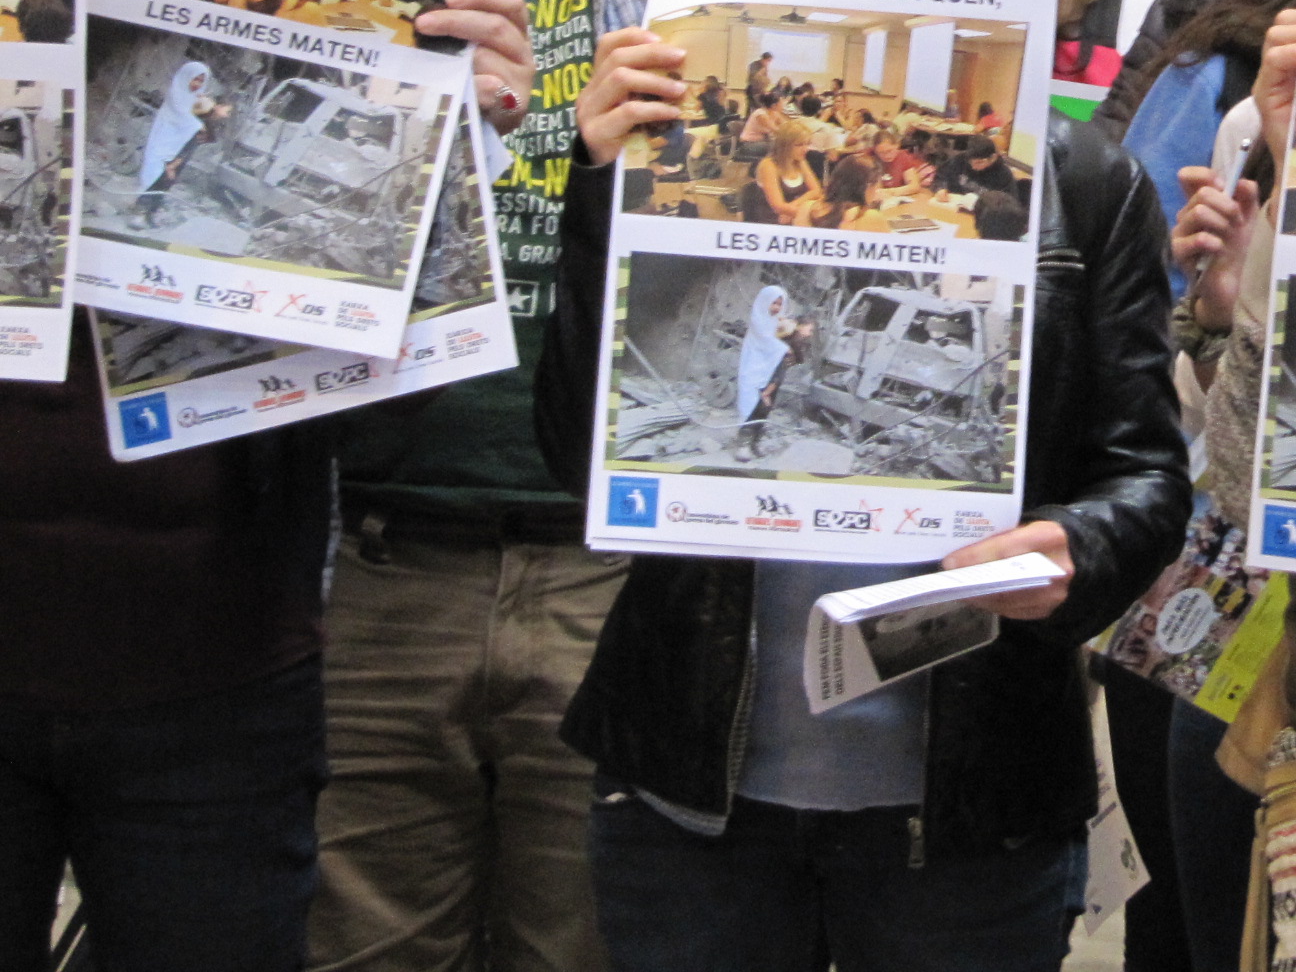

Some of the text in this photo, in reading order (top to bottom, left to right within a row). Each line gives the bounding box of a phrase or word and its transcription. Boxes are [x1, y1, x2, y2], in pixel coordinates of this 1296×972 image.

[145, 1, 381, 68] LES ARMES MATEN!
[716, 231, 947, 265] LES ARMES MATEN!
